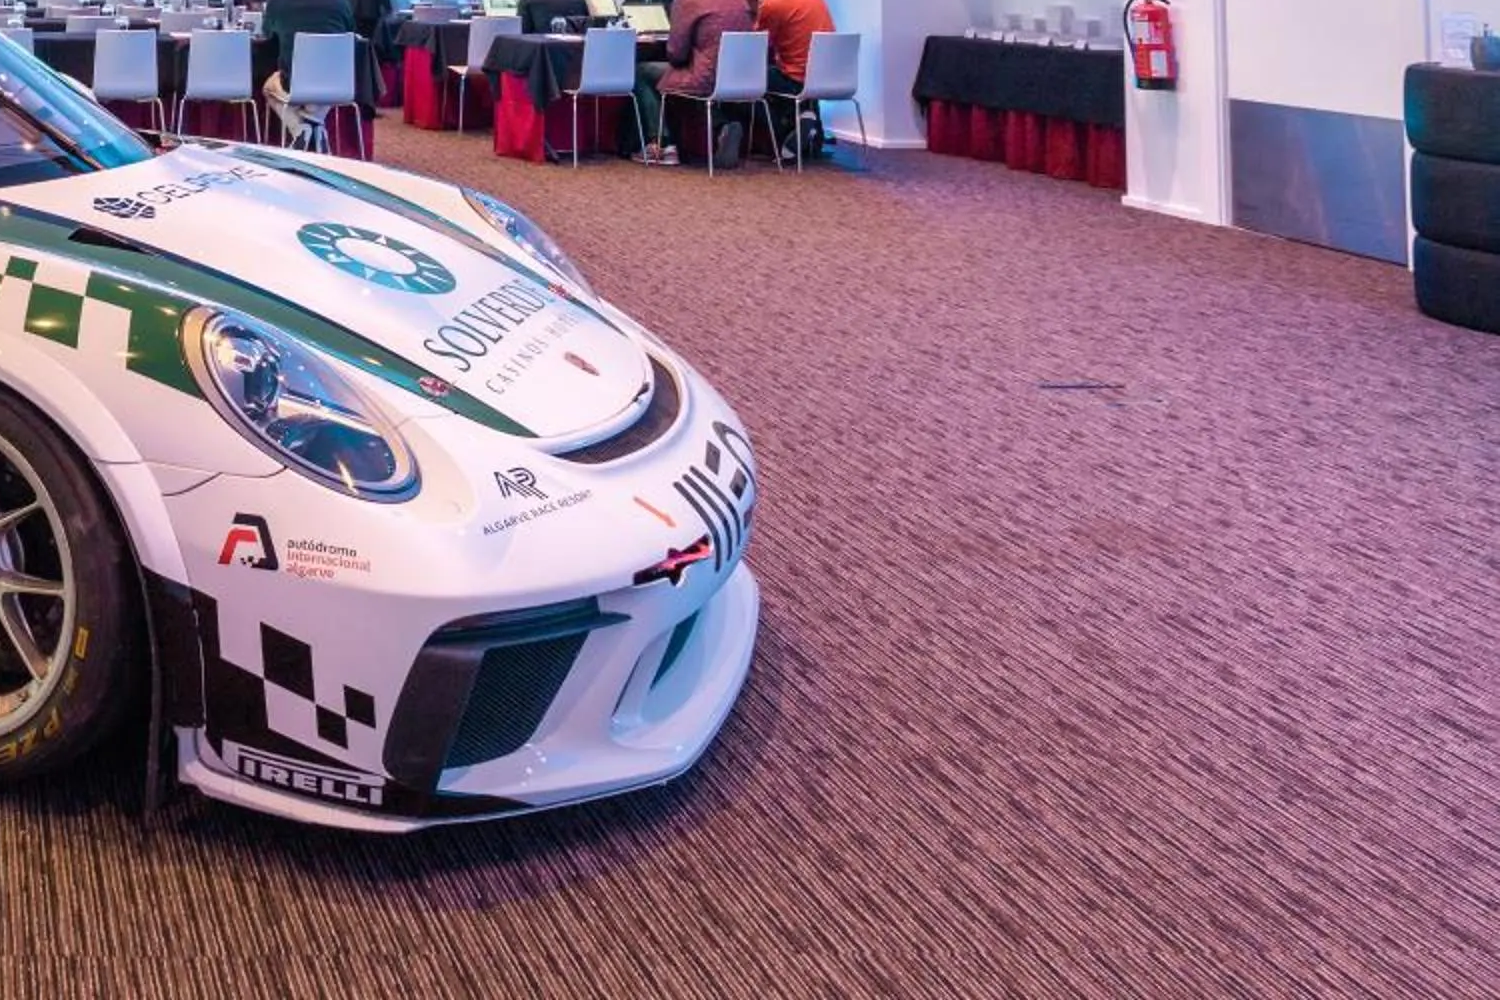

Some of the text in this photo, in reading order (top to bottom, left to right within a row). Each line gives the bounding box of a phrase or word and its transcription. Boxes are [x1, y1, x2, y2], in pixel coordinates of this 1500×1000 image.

[287, 538, 357, 557] autódromo
[287, 550, 371, 573] internacional
[222, 739, 387, 806] PIRELLI
